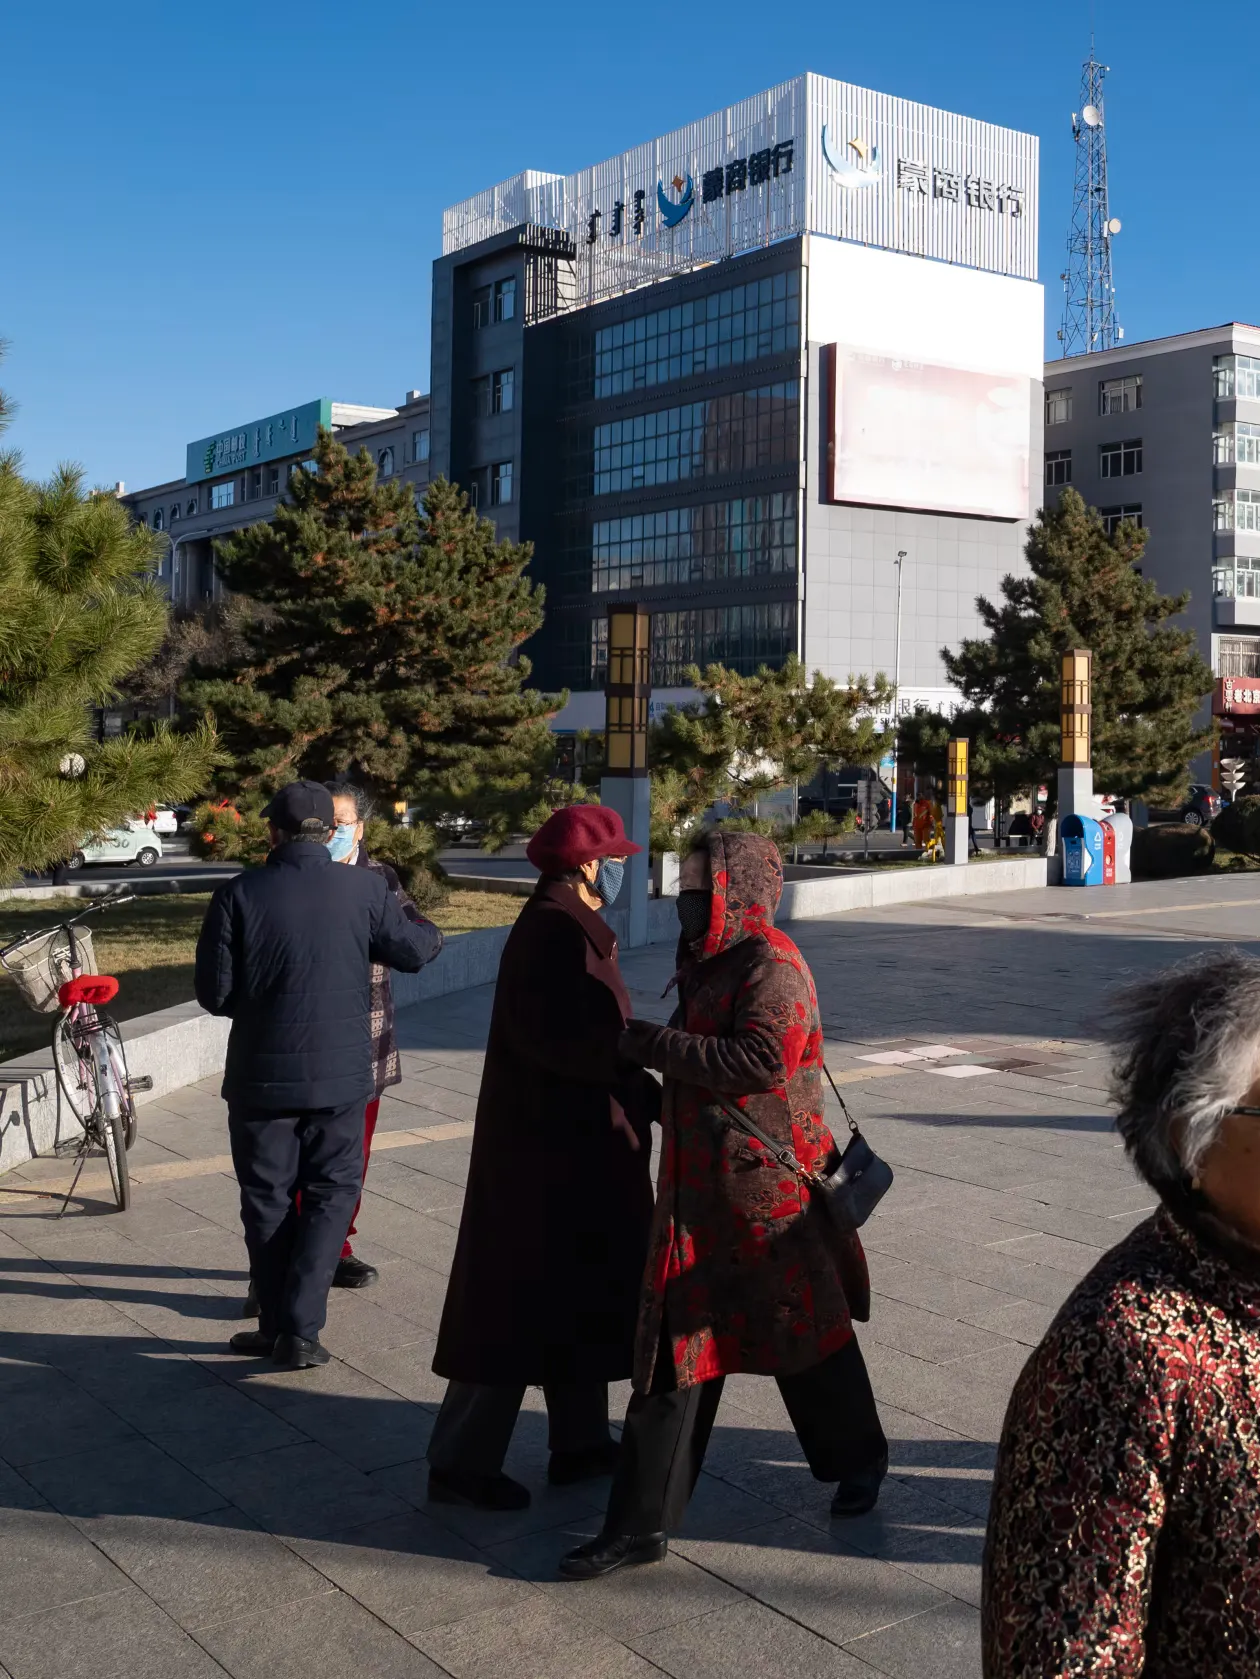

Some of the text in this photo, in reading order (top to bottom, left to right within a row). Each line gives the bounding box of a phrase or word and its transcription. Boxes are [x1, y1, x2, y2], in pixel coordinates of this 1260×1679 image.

[702, 139, 794, 205] 蒙商银行
[897, 157, 1026, 218] 蒙商银行
[216, 432, 247, 458] 中国邮政
